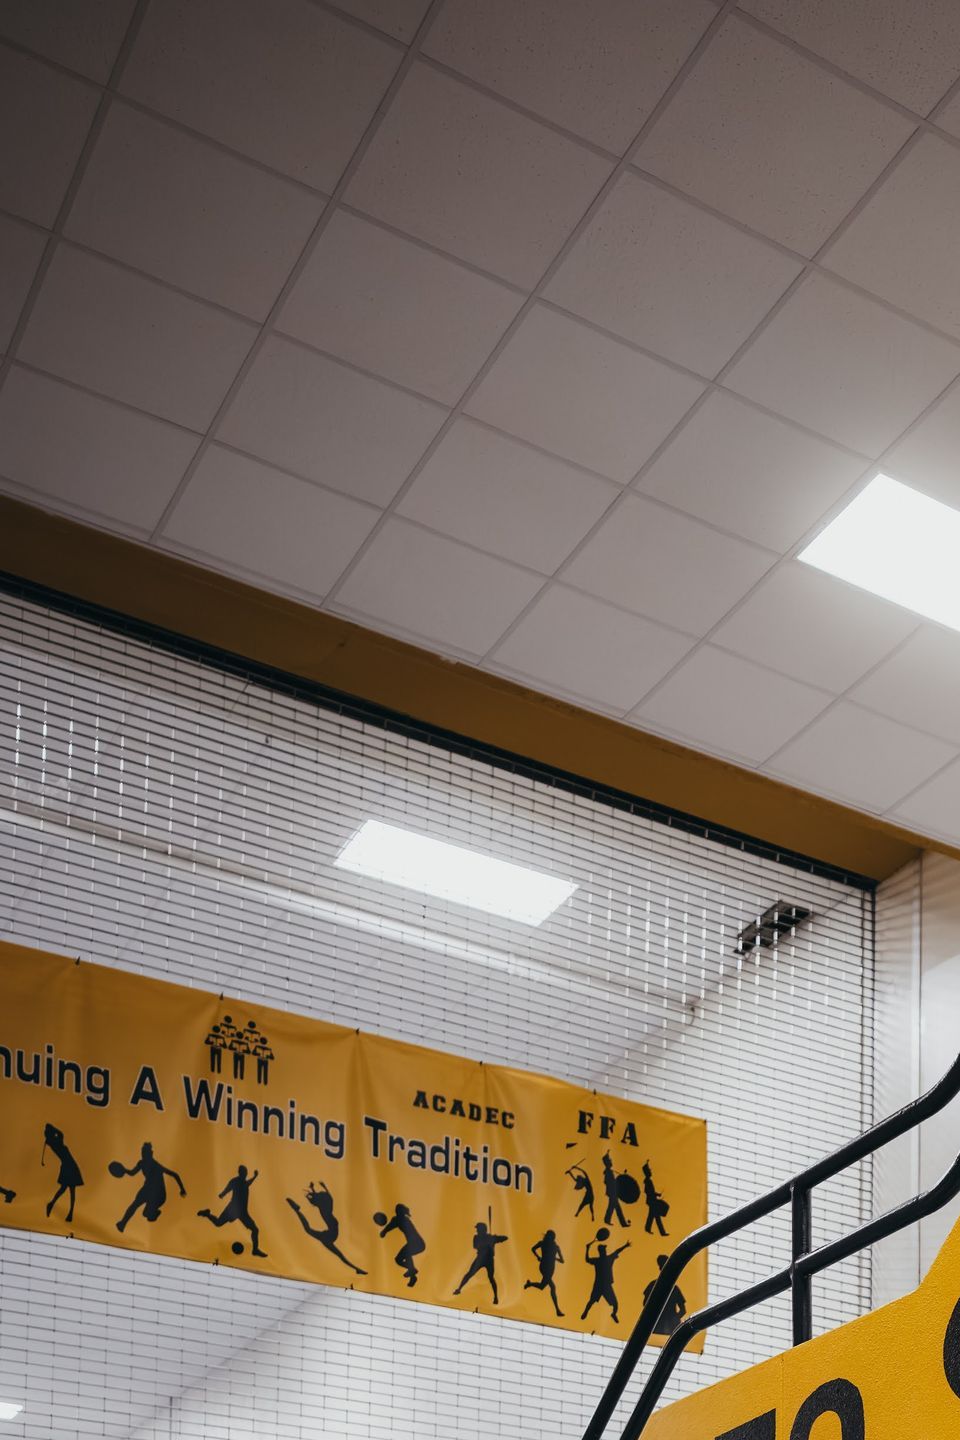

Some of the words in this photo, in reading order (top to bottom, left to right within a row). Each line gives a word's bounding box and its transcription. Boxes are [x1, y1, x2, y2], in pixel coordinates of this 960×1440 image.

[129, 1065, 164, 1111] A
[182, 1075, 345, 1159] Winning
[364, 1116, 533, 1193] Tradition
[413, 1090, 515, 1130] ACADEC
[577, 1110, 639, 1147] FFA
